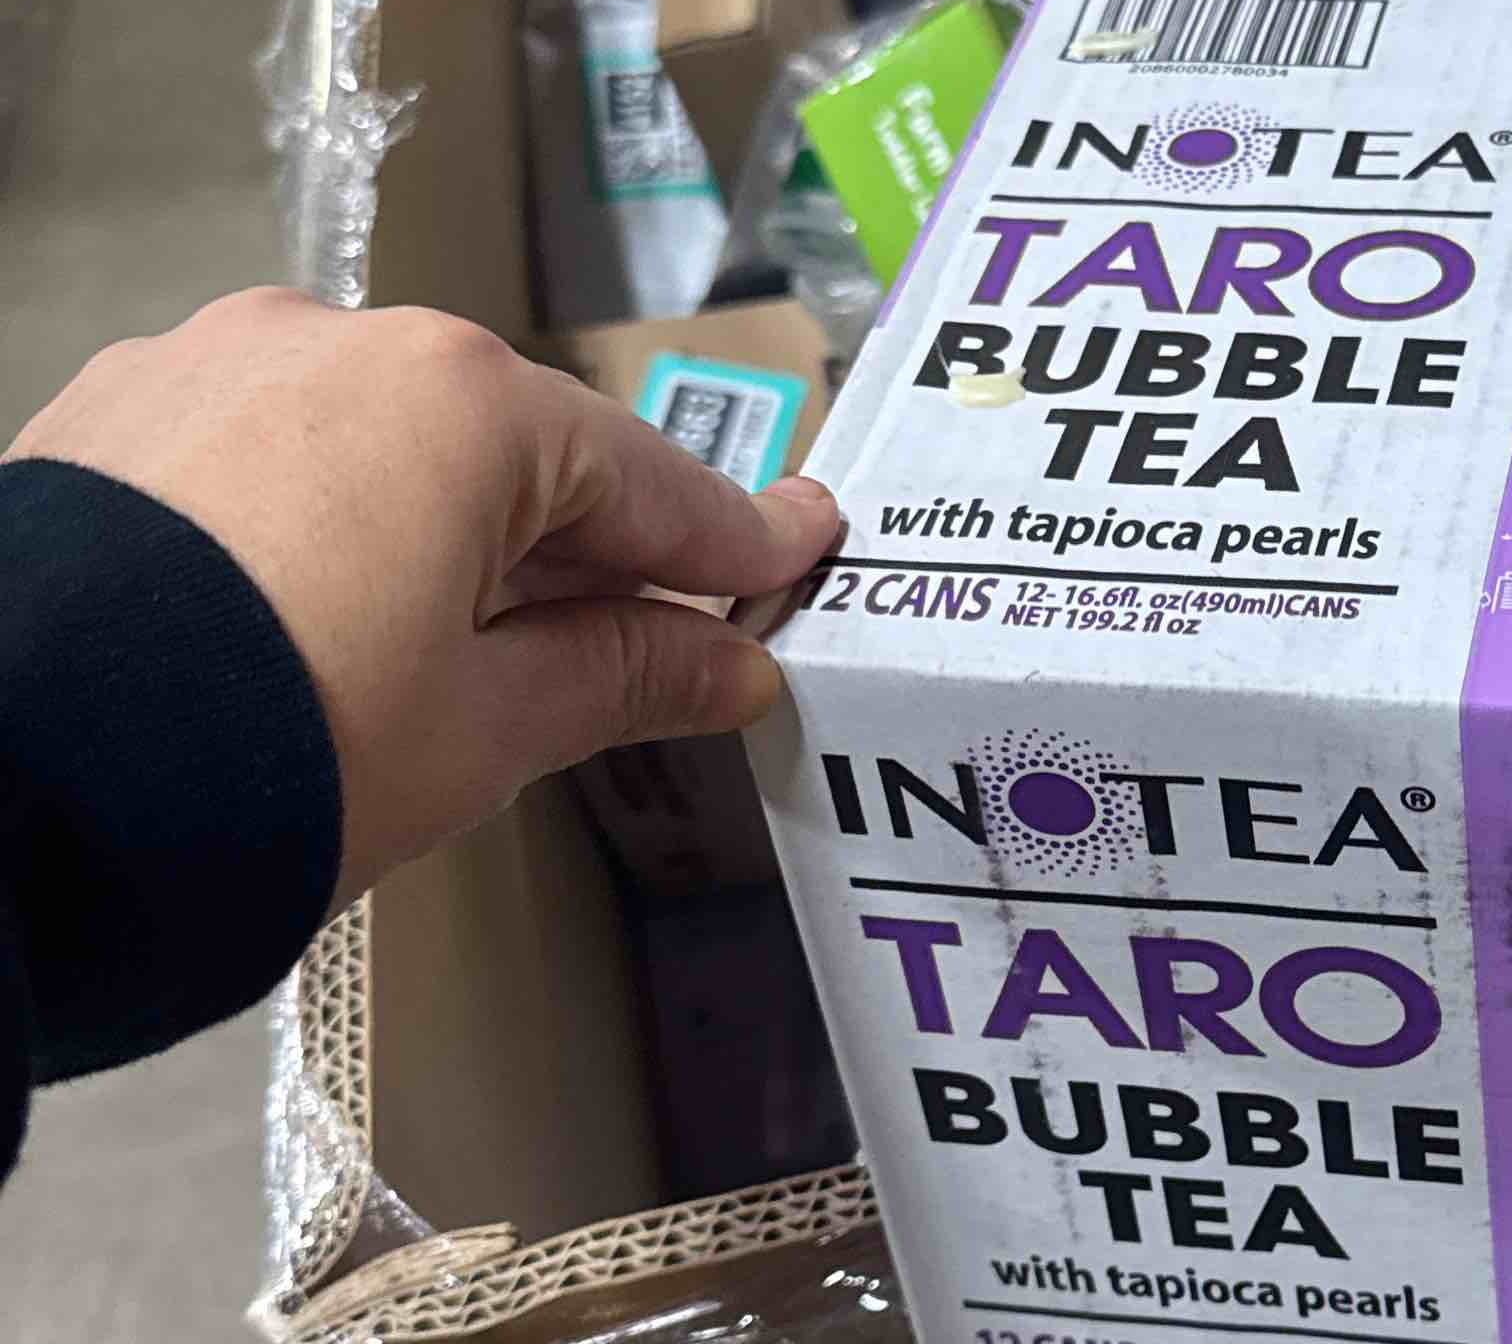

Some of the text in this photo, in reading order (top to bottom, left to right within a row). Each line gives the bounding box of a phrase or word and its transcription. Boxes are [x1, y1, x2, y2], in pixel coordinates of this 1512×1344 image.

[966, 216, 1478, 322] TARO
[912, 320, 1468, 409] BUBBLE
[1042, 408, 1302, 493] TEA
[878, 496, 1380, 563] with tapioca pearls
[864, 572, 1000, 622] CANS
[1001, 604, 1061, 629] NET
[1065, 606, 1138, 633] 199.2
[1165, 615, 1201, 636] oz
[859, 913, 1443, 1069] TARO
[911, 1067, 1465, 1186] BUBBLE
[1077, 1168, 1351, 1260] TEA
[991, 1254, 1441, 1324] with tapioca pearls
